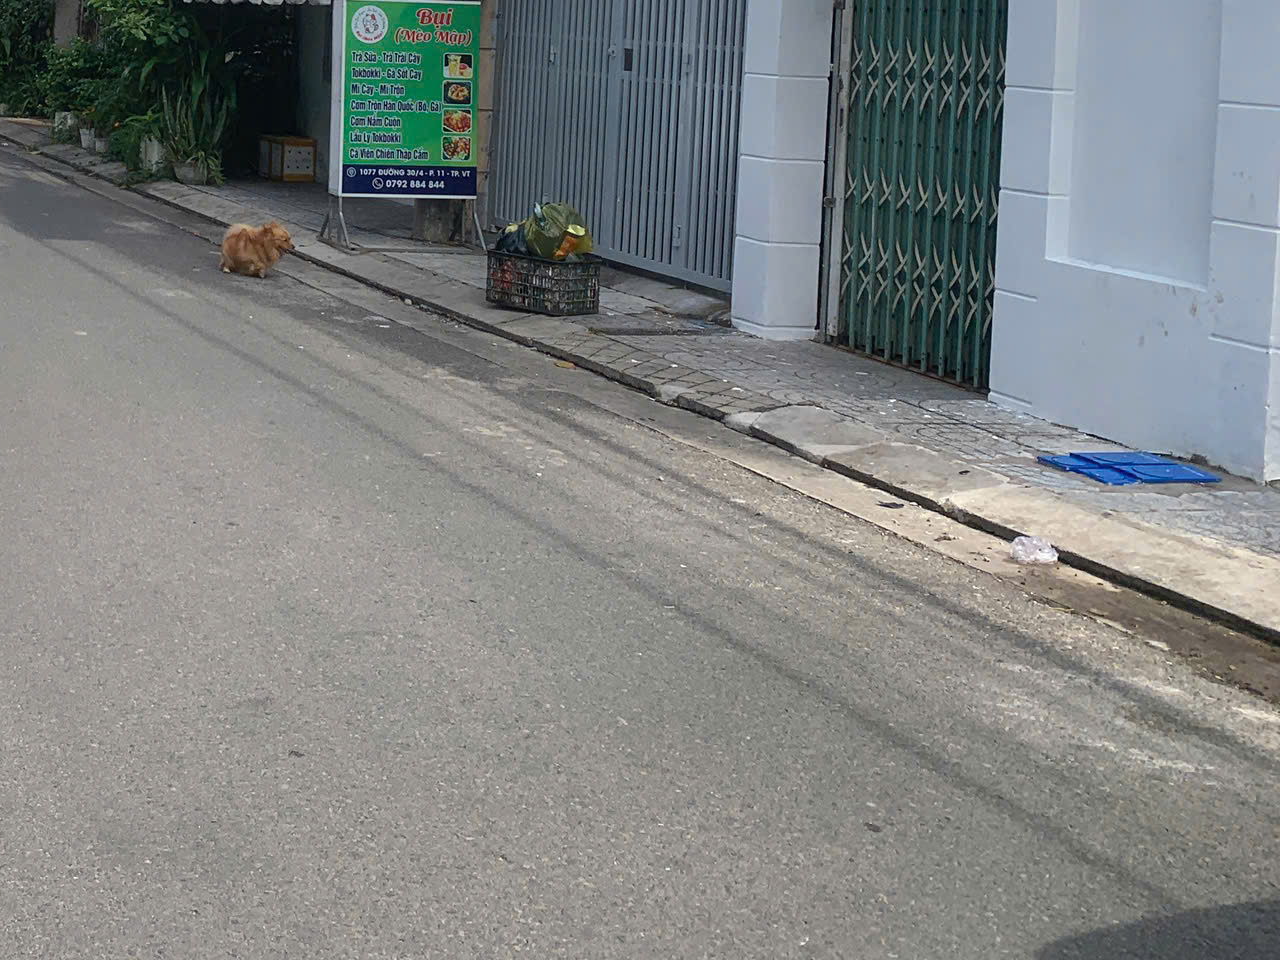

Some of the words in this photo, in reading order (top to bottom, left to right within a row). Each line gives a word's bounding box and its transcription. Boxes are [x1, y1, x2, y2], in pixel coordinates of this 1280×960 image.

[416, 8, 453, 29] Bụi
[394, 26, 432, 45] (Mèo
[434, 28, 472, 47] Mập)
[351, 67, 381, 79] Tokbokki
[361, 83, 374, 96] Cay
[372, 132, 401, 143] Tokbokki
[359, 168, 376, 176] 1077
[378, 167, 405, 176] ĐƯỜNG
[406, 169, 424, 177] 30/4
[428, 169, 435, 177] P.
[451, 170, 460, 178] TP.
[461, 170, 471, 178] VT
[385, 179, 408, 188] 0792
[409, 180, 426, 188] 884
[428, 180, 445, 189] 844
